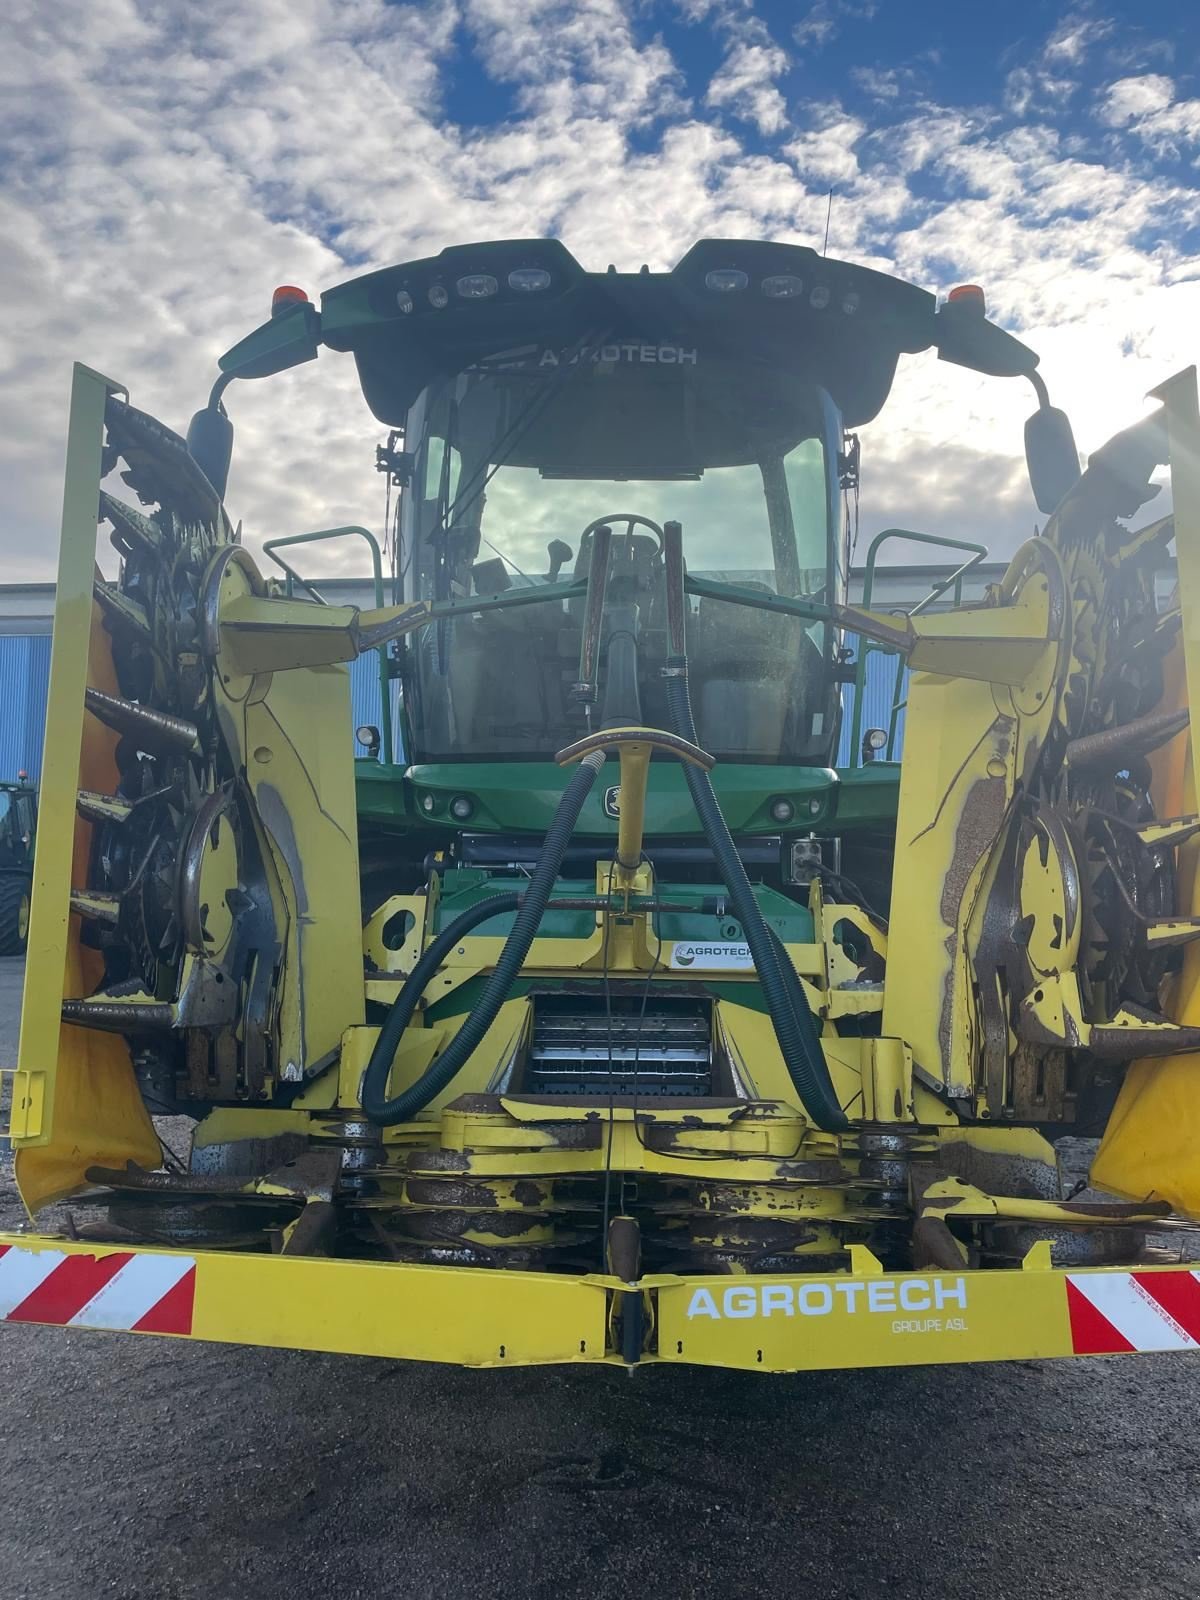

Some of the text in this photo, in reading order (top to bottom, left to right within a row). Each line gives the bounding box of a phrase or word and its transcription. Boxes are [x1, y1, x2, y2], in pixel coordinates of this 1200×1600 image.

[687, 1278, 968, 1320] AGROTECH
[892, 1318, 968, 1333] GROUPE ASL
